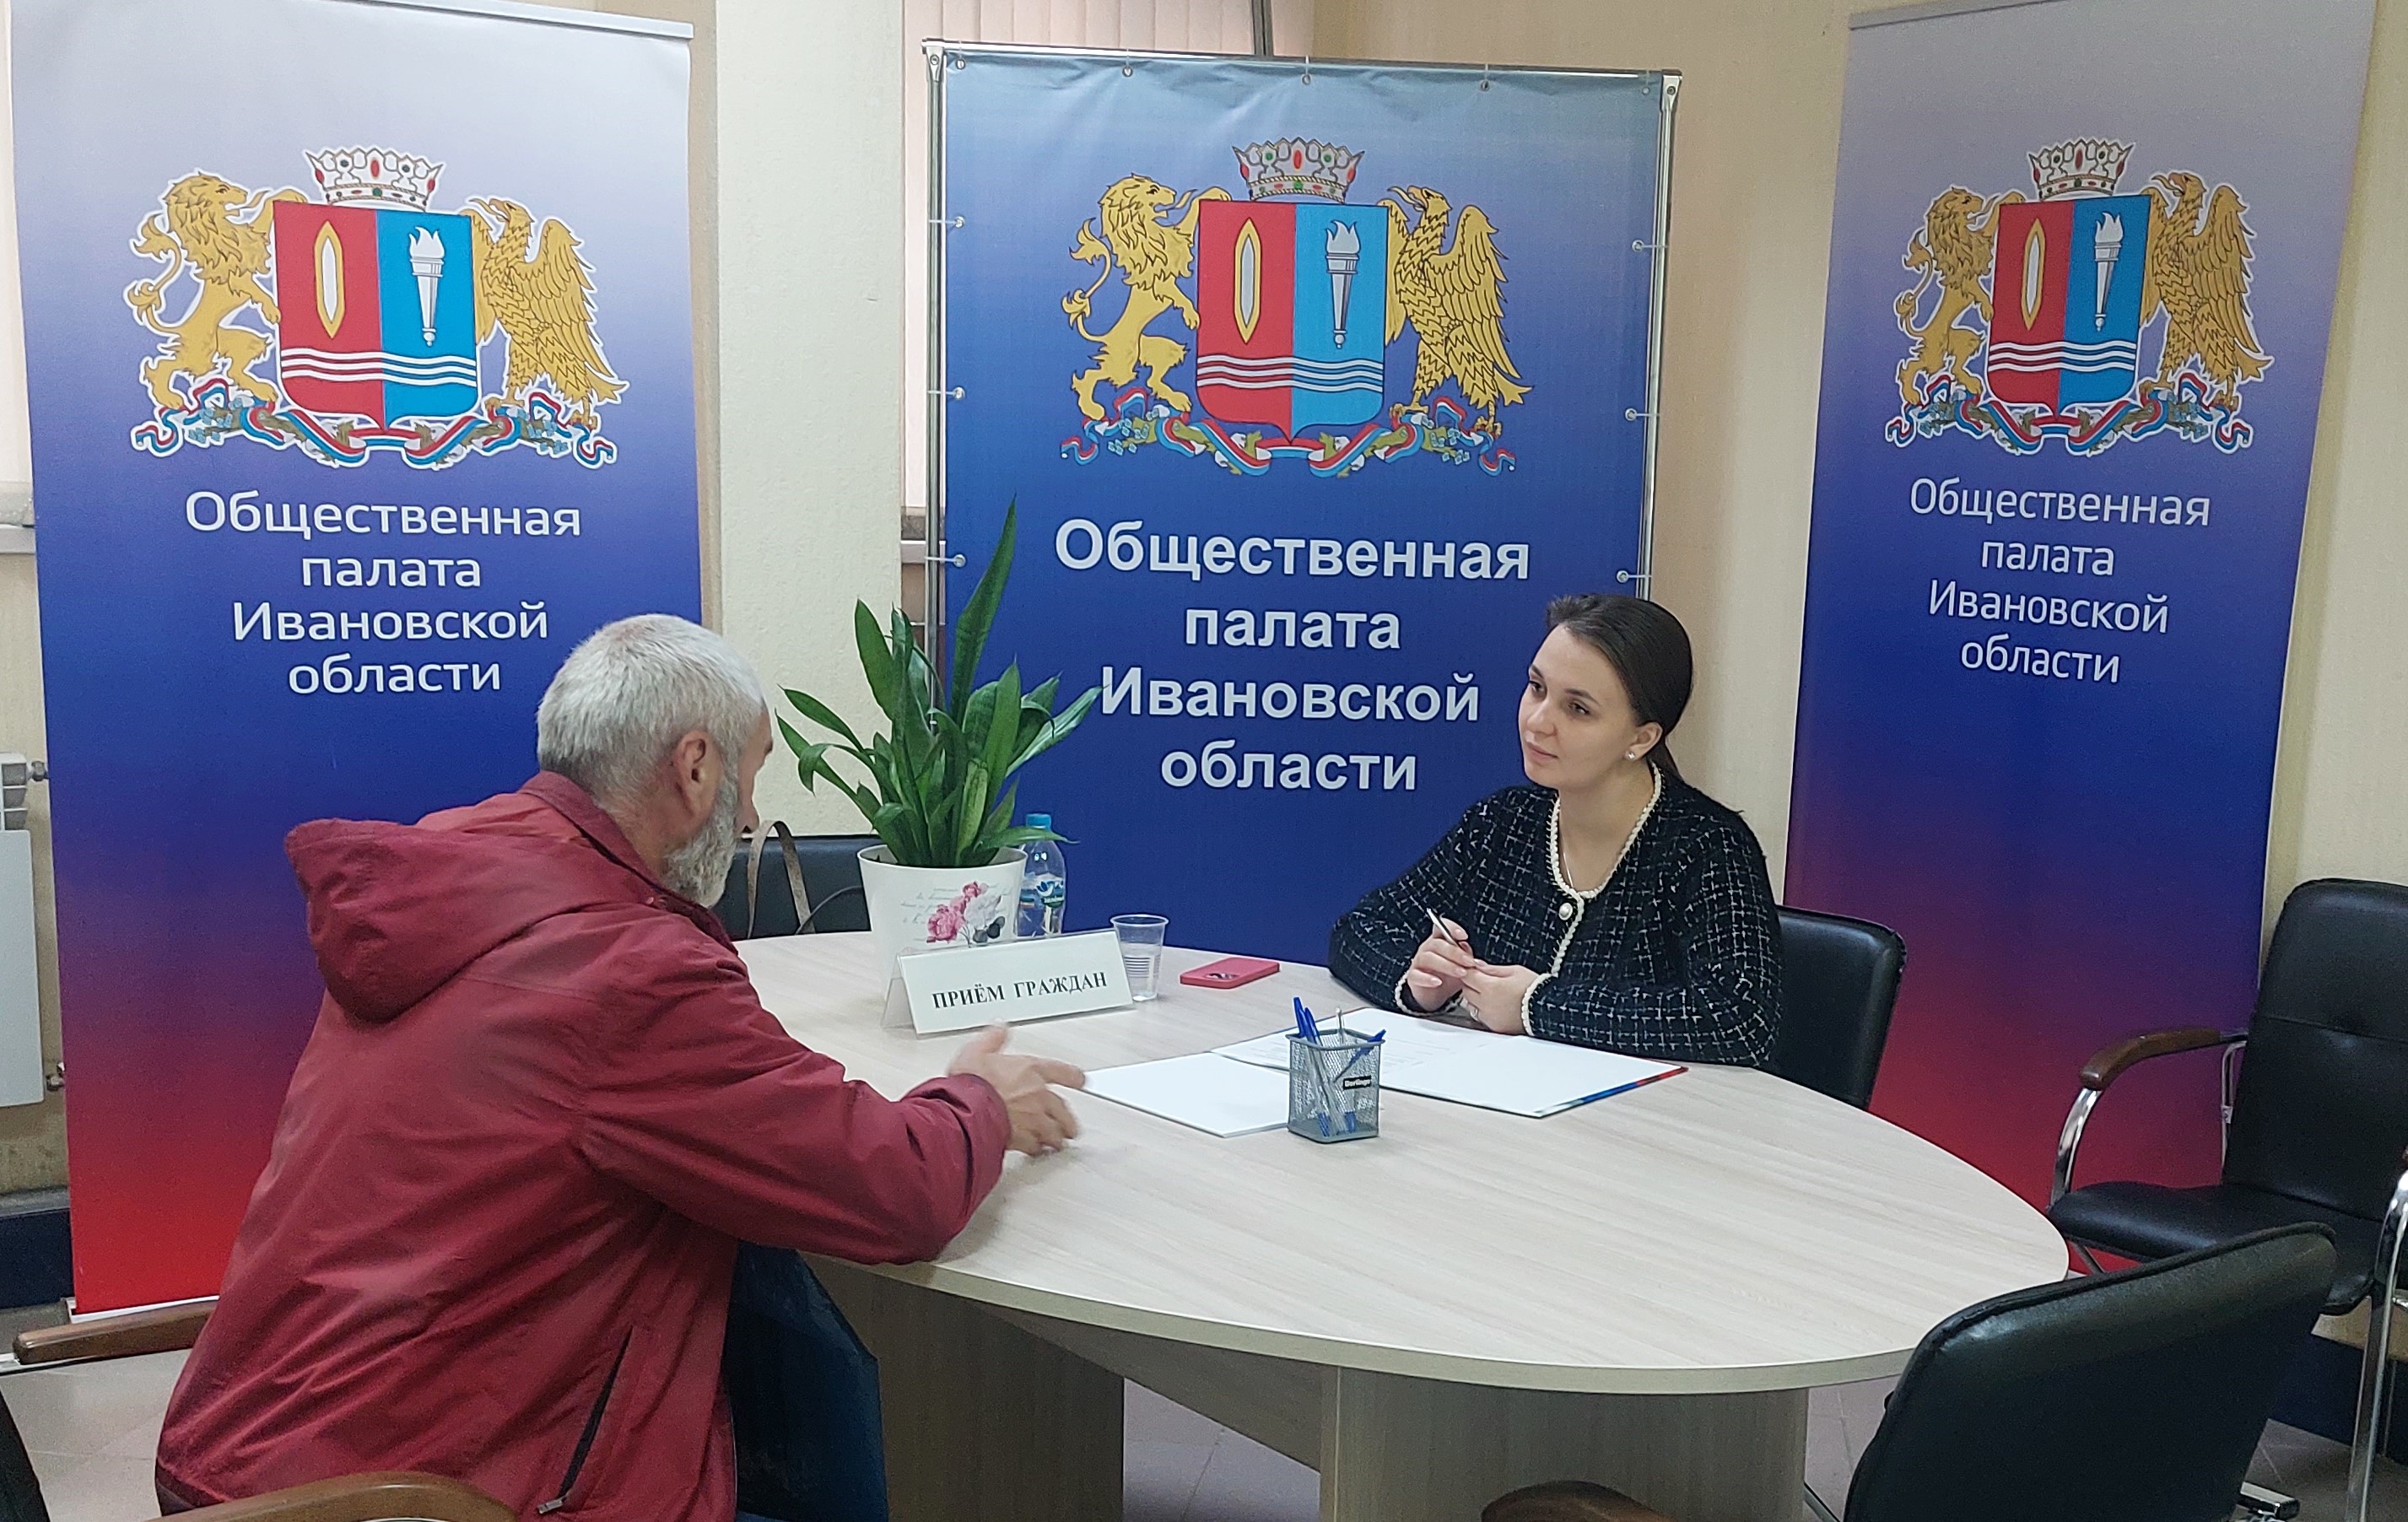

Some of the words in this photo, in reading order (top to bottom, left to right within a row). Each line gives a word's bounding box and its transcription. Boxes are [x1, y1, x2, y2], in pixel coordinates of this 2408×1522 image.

[186, 489, 580, 538] Общественная
[1910, 477, 2210, 526] Общественная
[302, 558, 481, 587] палата
[1056, 519, 1529, 581] Общественная
[1982, 541, 2114, 575] палата
[234, 601, 548, 640] Ивановской
[1186, 609, 1400, 649] палата
[1929, 580, 2168, 633] Ивановской
[289, 652, 500, 694] области
[1962, 633, 2119, 683] области
[1102, 667, 1478, 721] Ивановской
[1161, 739, 1416, 790] области
[931, 983, 1005, 1009] ПРИЁМ
[1013, 972, 1107, 998] ГРАЖДАН
